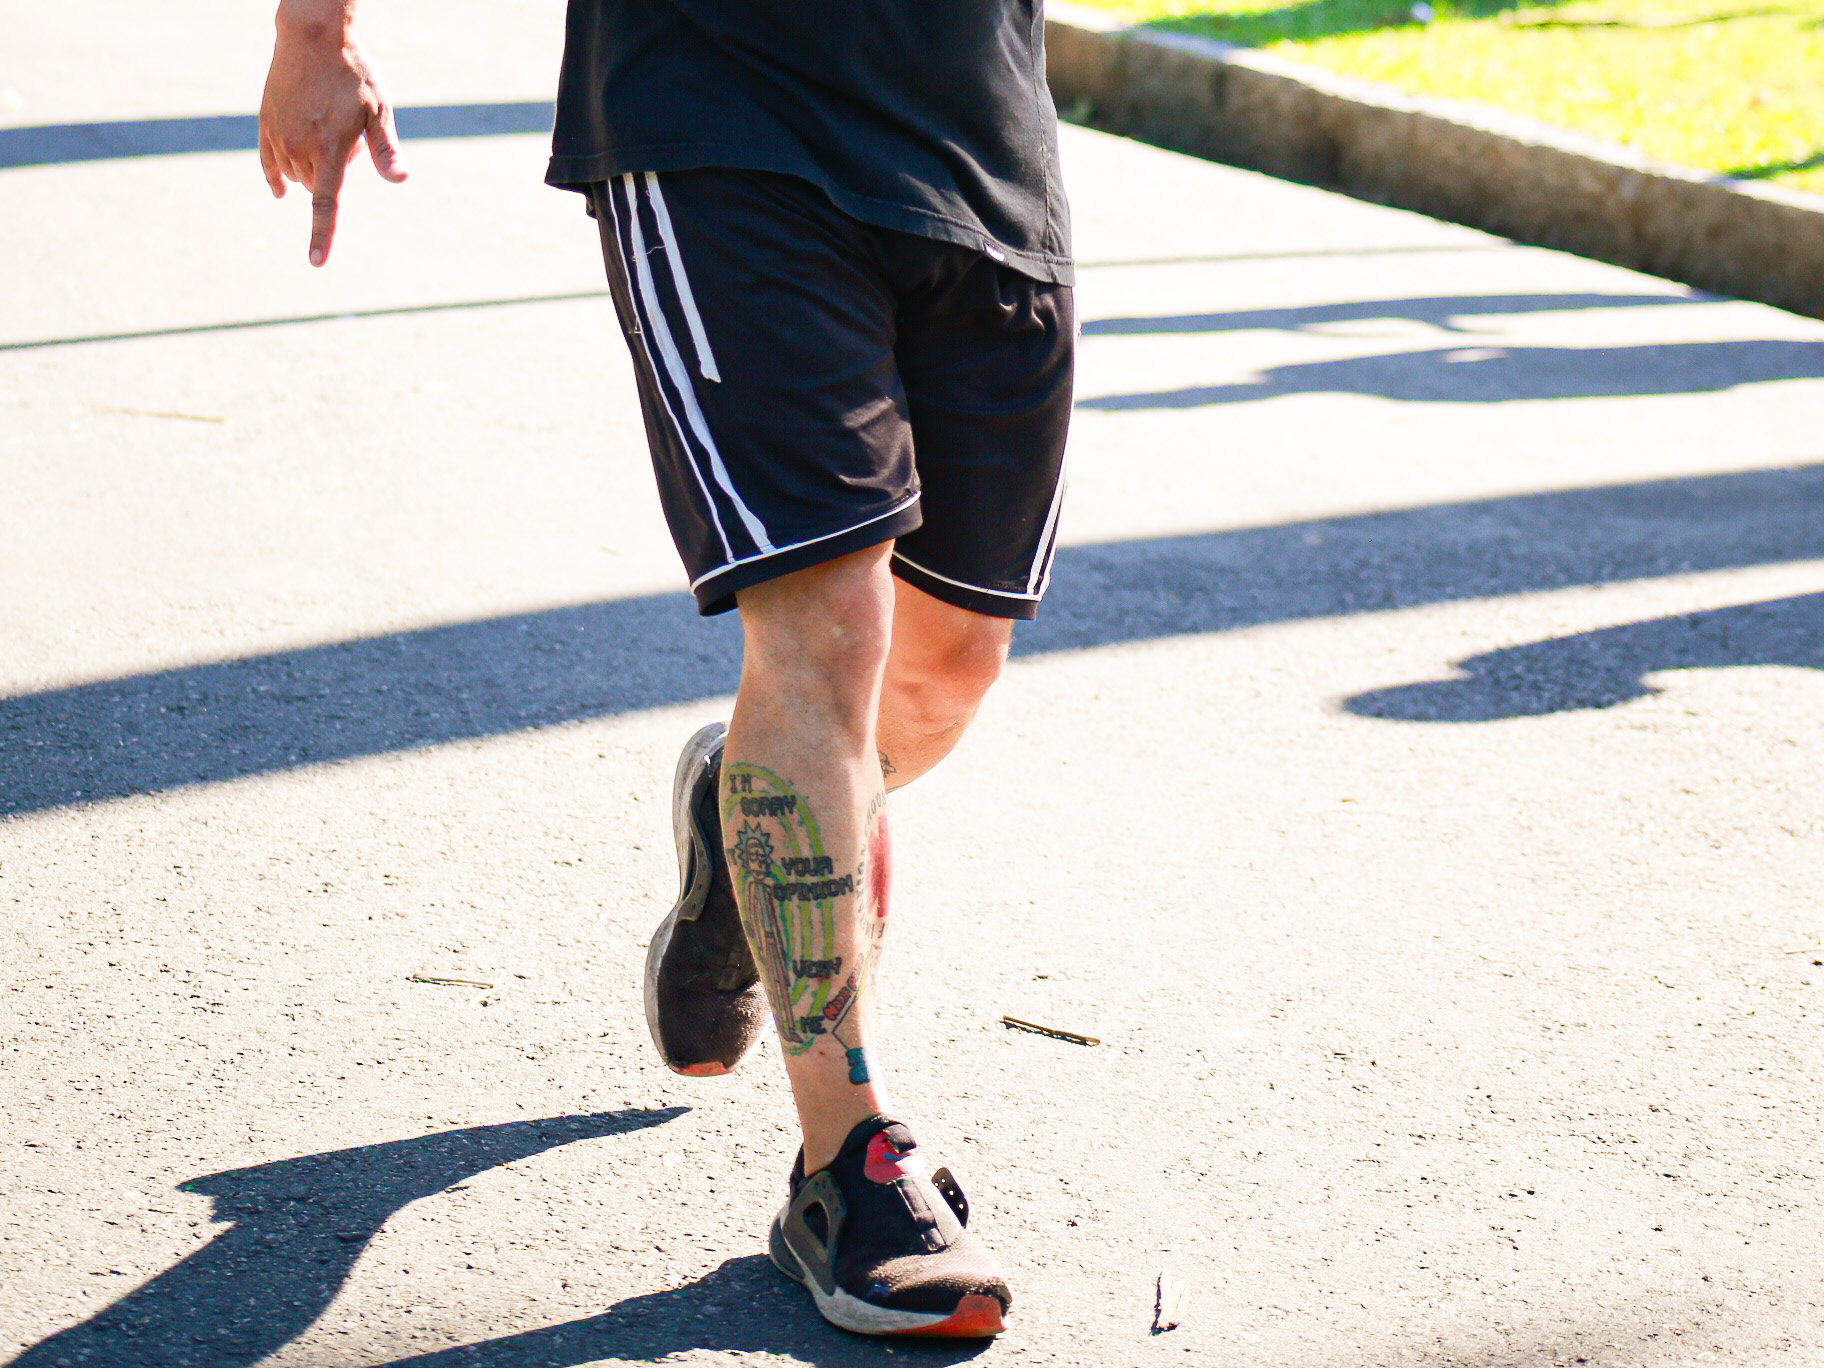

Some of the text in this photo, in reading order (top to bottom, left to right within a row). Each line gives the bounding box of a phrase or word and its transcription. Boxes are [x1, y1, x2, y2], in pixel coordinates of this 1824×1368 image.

[740, 794, 797, 818] SORRY
[780, 855, 834, 877] YOUR
[772, 874, 854, 902] OPINION
[791, 956, 843, 979] VERY
[800, 1015, 827, 1035] ME
